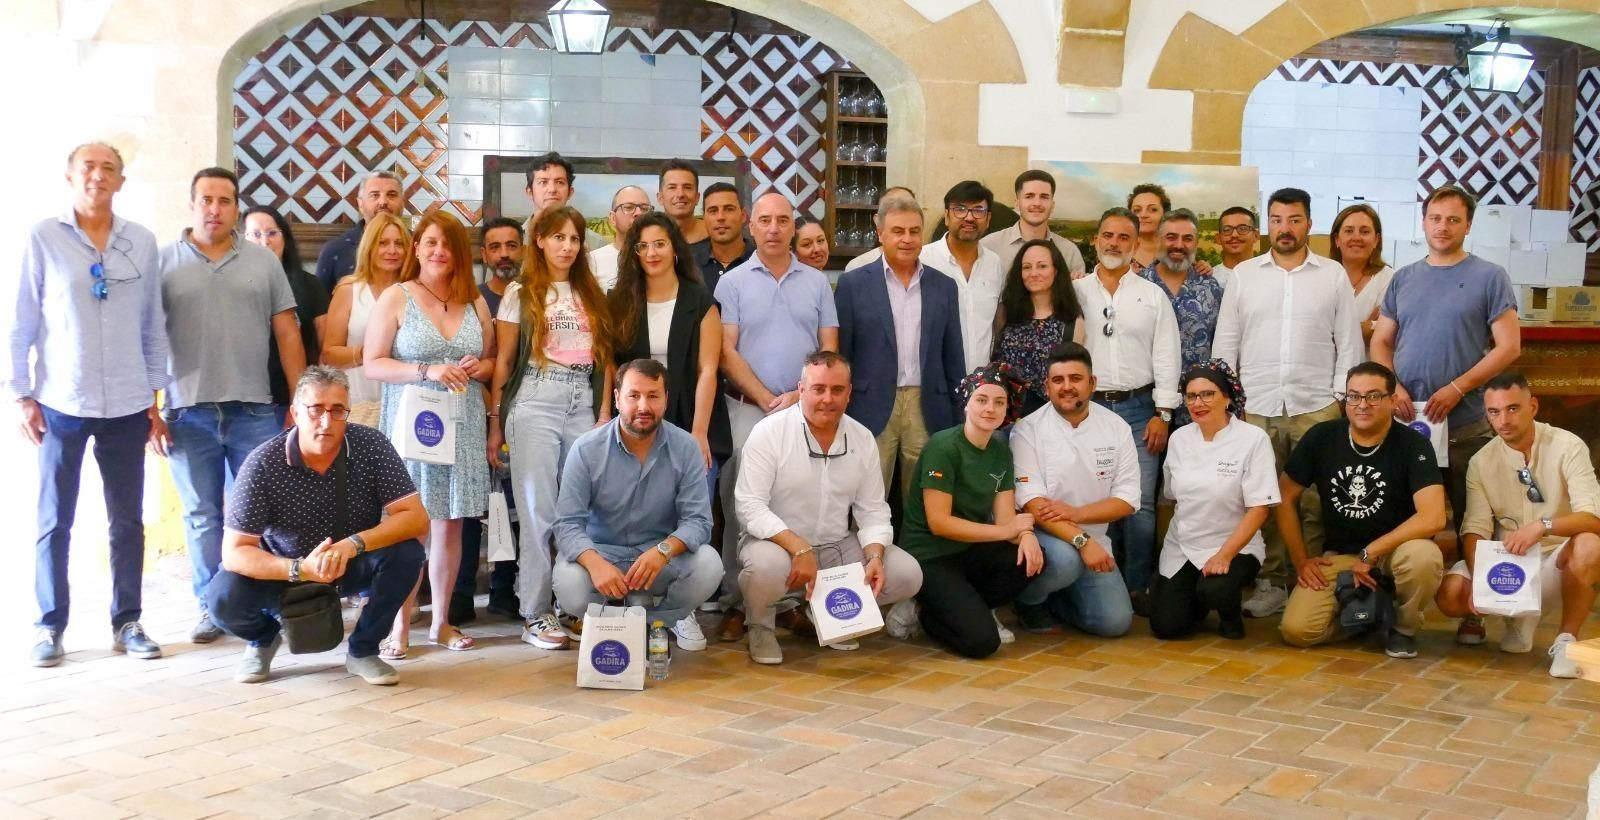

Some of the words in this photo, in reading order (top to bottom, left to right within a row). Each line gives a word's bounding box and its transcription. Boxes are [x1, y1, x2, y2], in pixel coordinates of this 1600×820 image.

[417, 427, 441, 438] GADIRA
[1330, 464, 1387, 488] PIRATAS
[1330, 496, 1344, 513] DEL
[1344, 497, 1384, 519] TRASTERO
[1490, 576, 1521, 586] GADIRA
[830, 602, 860, 615] GADIRA
[595, 656, 626, 667] GADIRA
